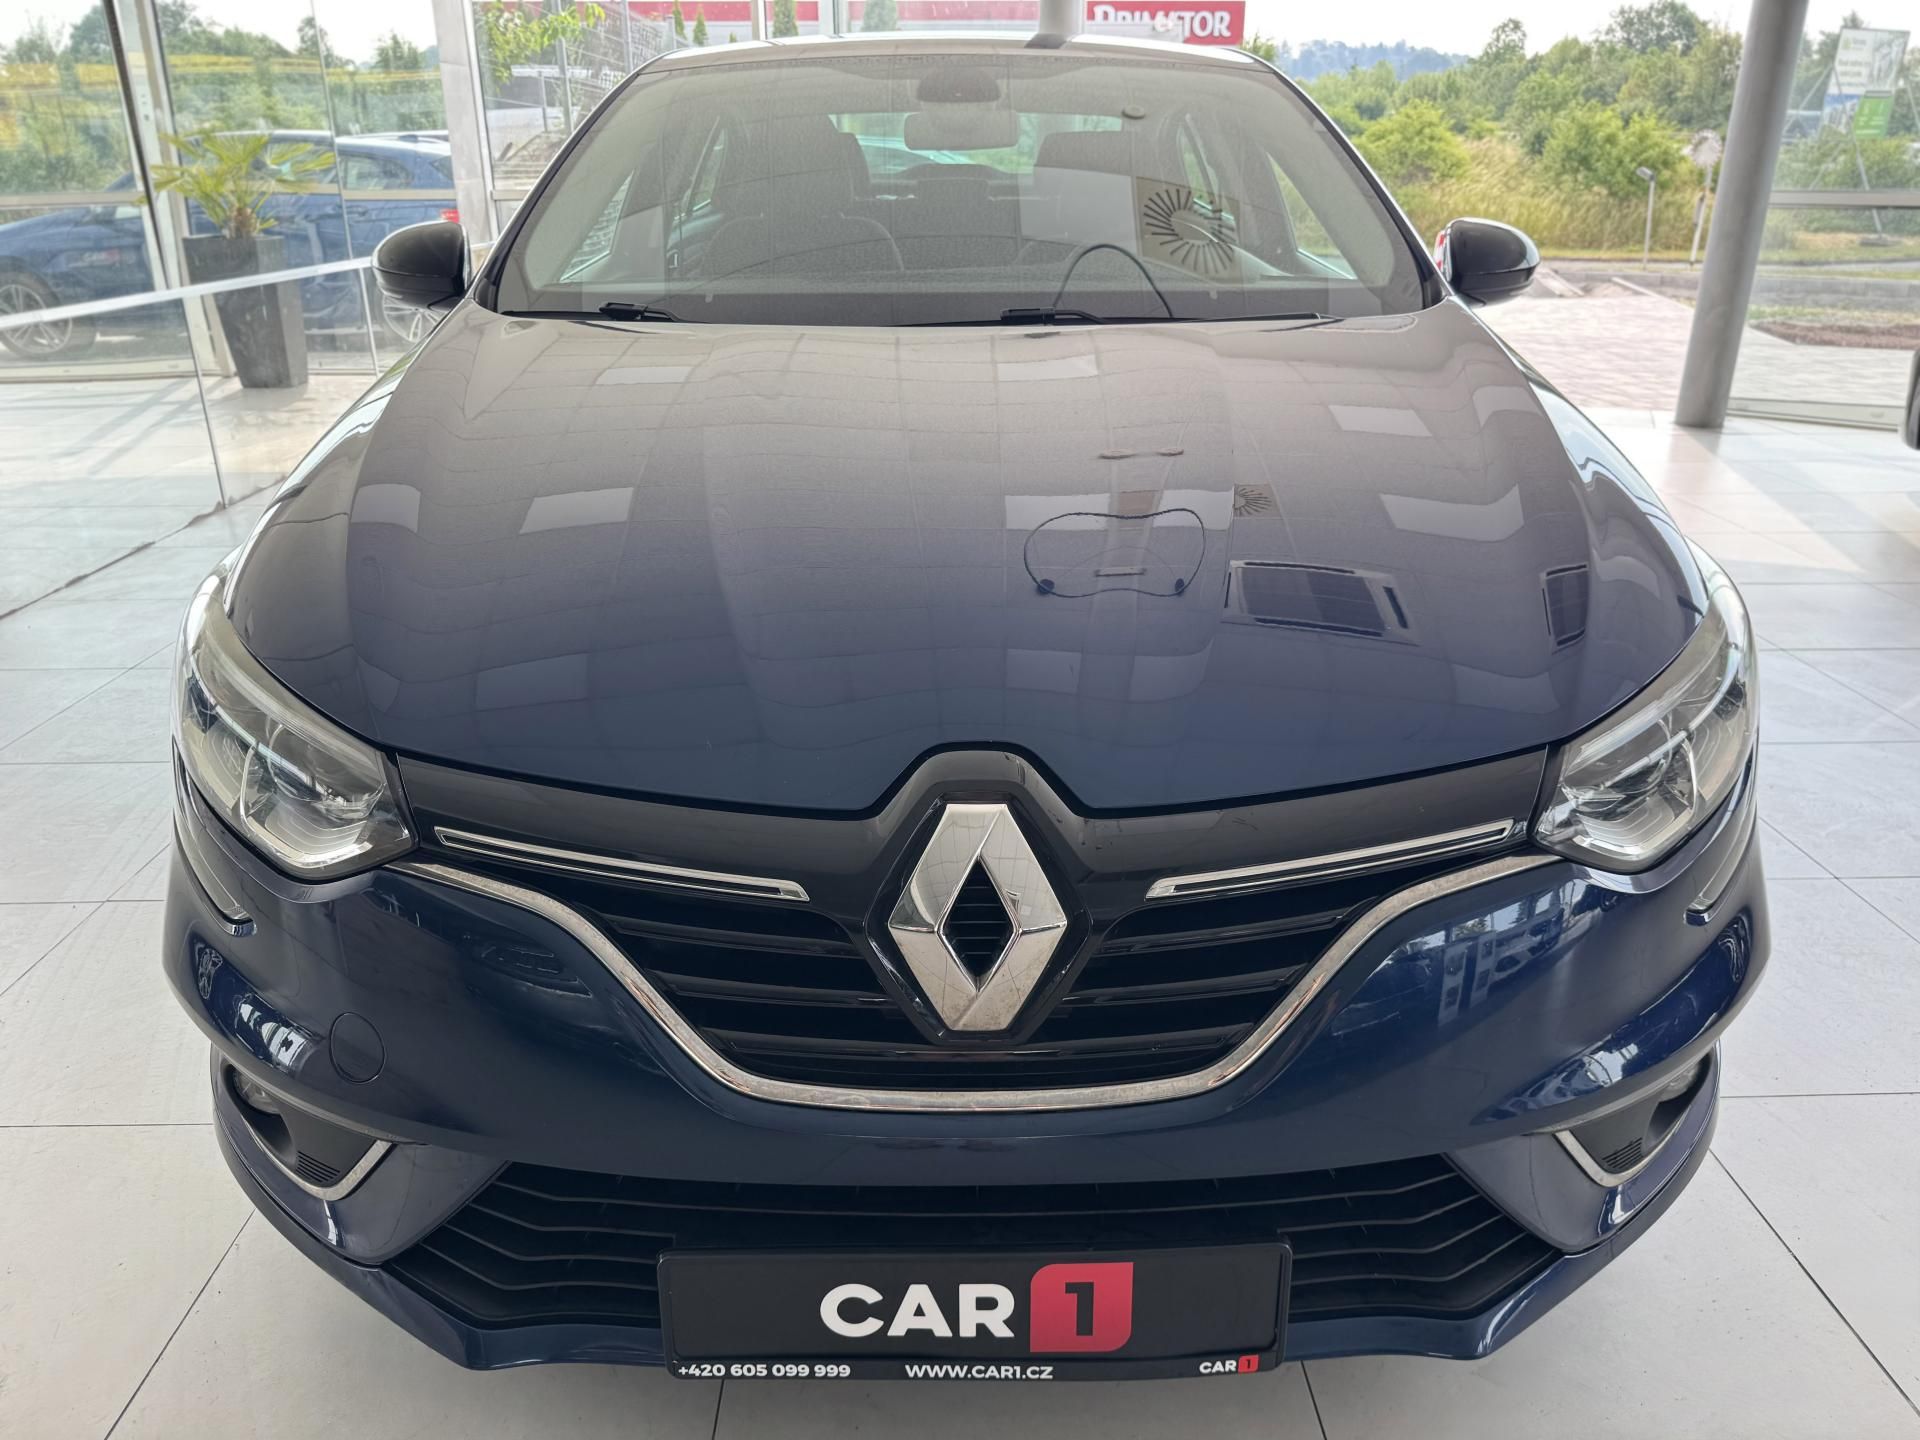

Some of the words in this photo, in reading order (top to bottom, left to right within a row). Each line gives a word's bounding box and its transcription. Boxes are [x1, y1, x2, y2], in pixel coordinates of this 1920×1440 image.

[820, 1283, 1015, 1338] CAR
[1065, 1281, 1095, 1336] 1
[678, 1364, 726, 1377] +420
[730, 1364, 768, 1377] 605
[771, 1364, 810, 1377] 099
[814, 1364, 851, 1377] 999
[904, 1364, 1054, 1380] WWW.CAR1.CZ
[1199, 1360, 1237, 1373] CAR
